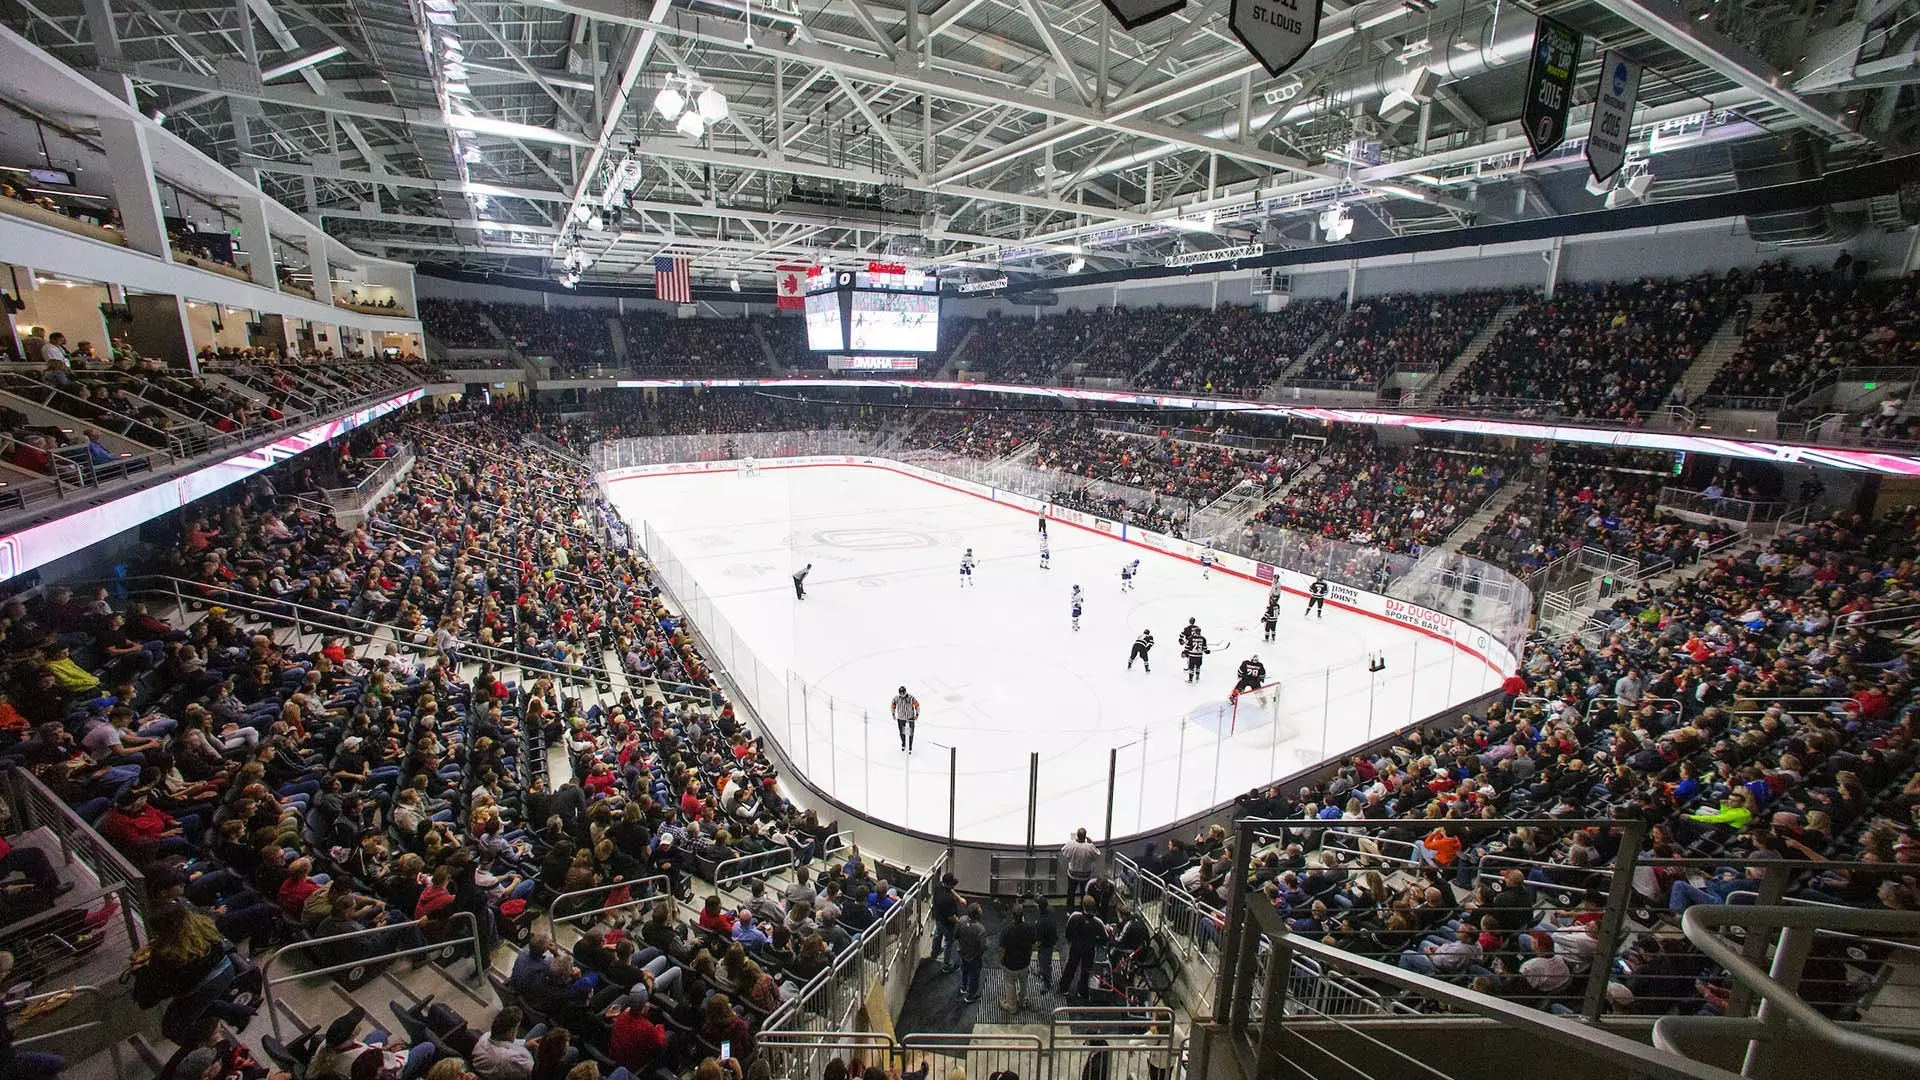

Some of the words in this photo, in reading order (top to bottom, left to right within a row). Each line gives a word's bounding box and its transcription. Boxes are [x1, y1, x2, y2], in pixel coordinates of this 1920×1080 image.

[1253, 5, 1268, 23] ST.
[1270, 11, 1302, 35] LOUIS
[1538, 79, 1563, 110] 2015
[1601, 111, 1621, 137] 2015
[853, 357, 893, 370] OMAHA
[1330, 592, 1358, 605] JOHN'S
[1331, 585, 1358, 598] JIMMY
[1384, 609, 1420, 625] SPORTS
[1421, 620, 1439, 632] BAR
[1407, 605, 1456, 630] DUGOUT
